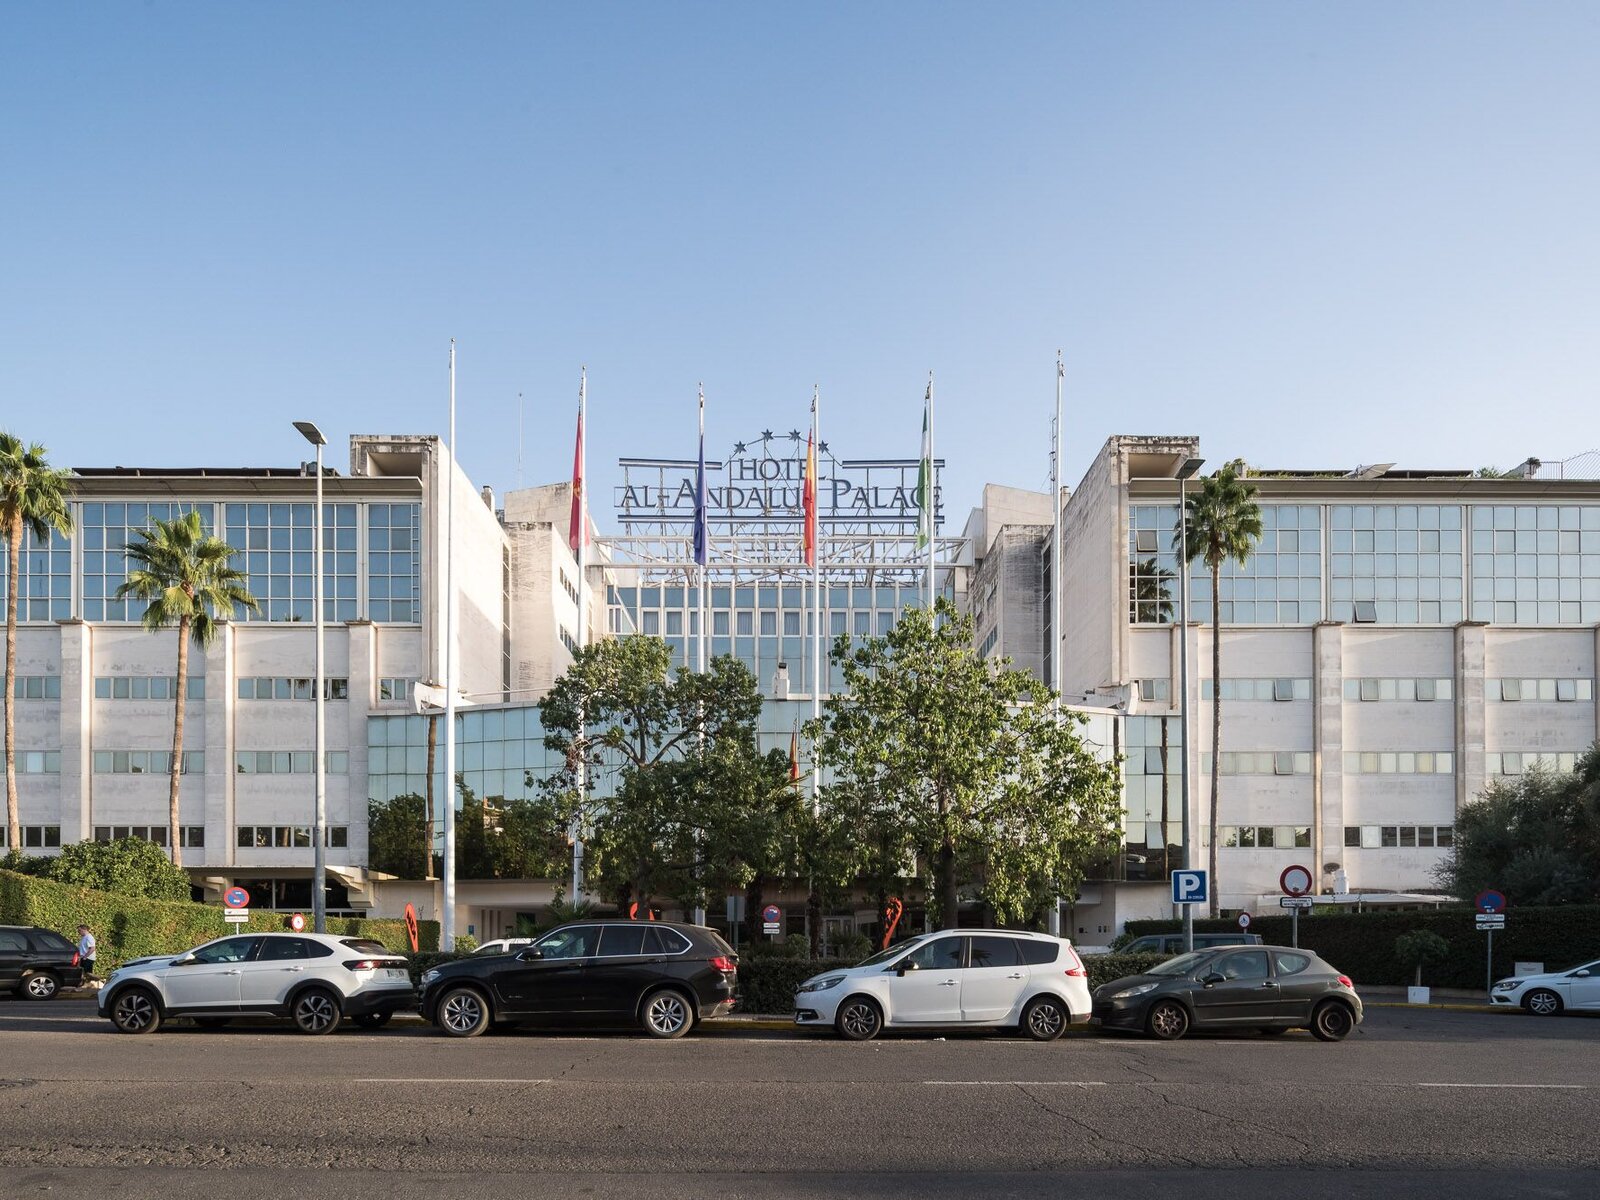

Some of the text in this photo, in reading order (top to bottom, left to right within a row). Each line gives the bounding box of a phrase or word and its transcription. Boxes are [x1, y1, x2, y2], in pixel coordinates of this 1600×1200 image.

[739, 458, 826, 481] HOTE
[620, 478, 816, 509] AL-ANDALU
[1179, 873, 1200, 900] P
